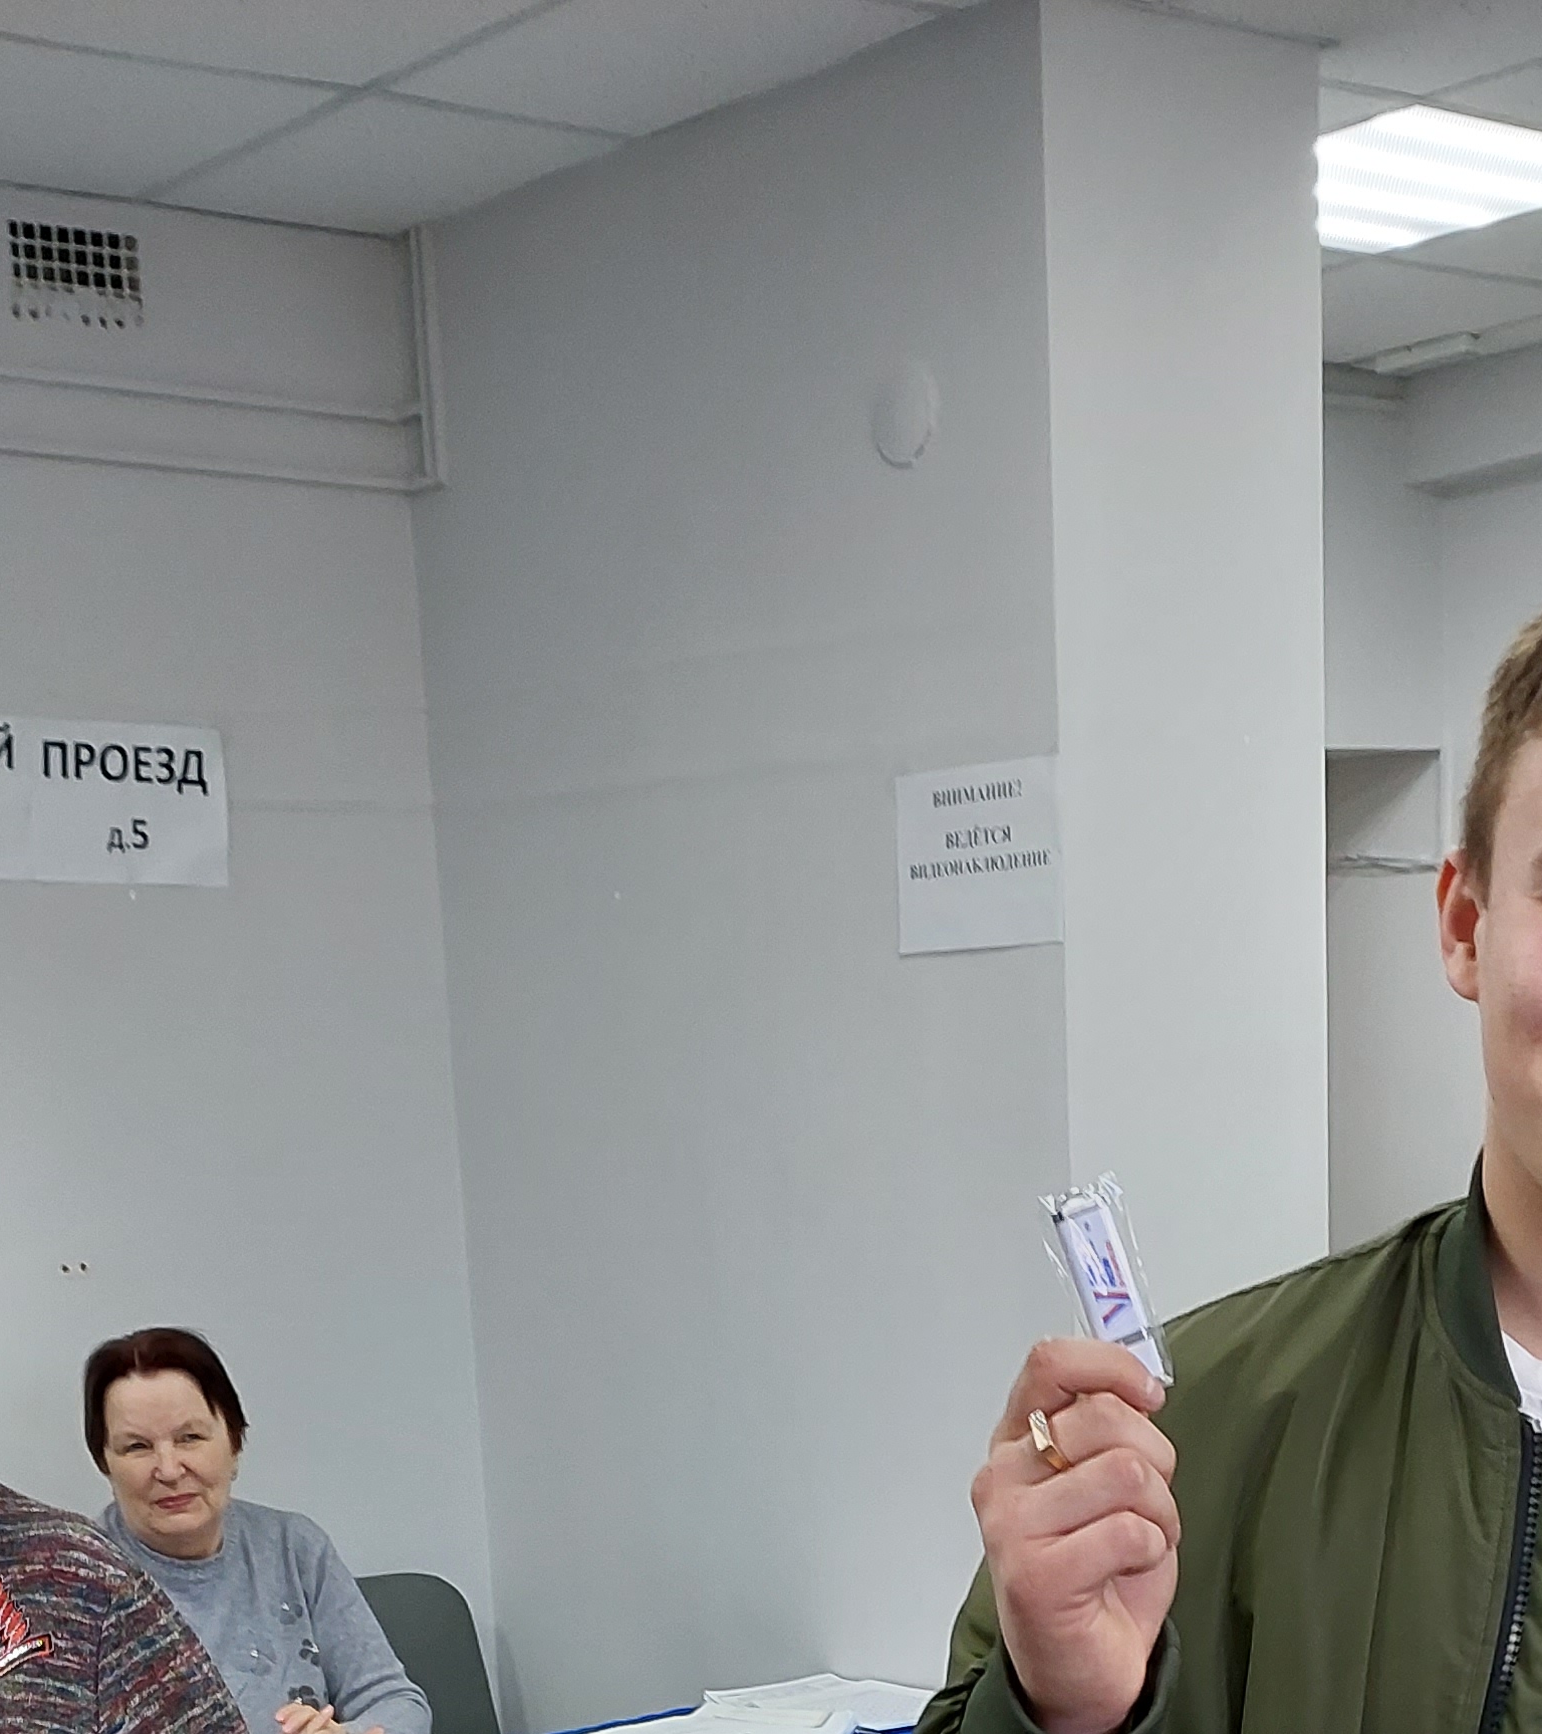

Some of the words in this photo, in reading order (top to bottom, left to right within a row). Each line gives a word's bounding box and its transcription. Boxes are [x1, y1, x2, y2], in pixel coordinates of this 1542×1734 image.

[41, 738, 210, 796] ПРОЕЗД
[931, 778, 1022, 810] ВНИМАНИЕ!
[106, 817, 150, 855] д.5
